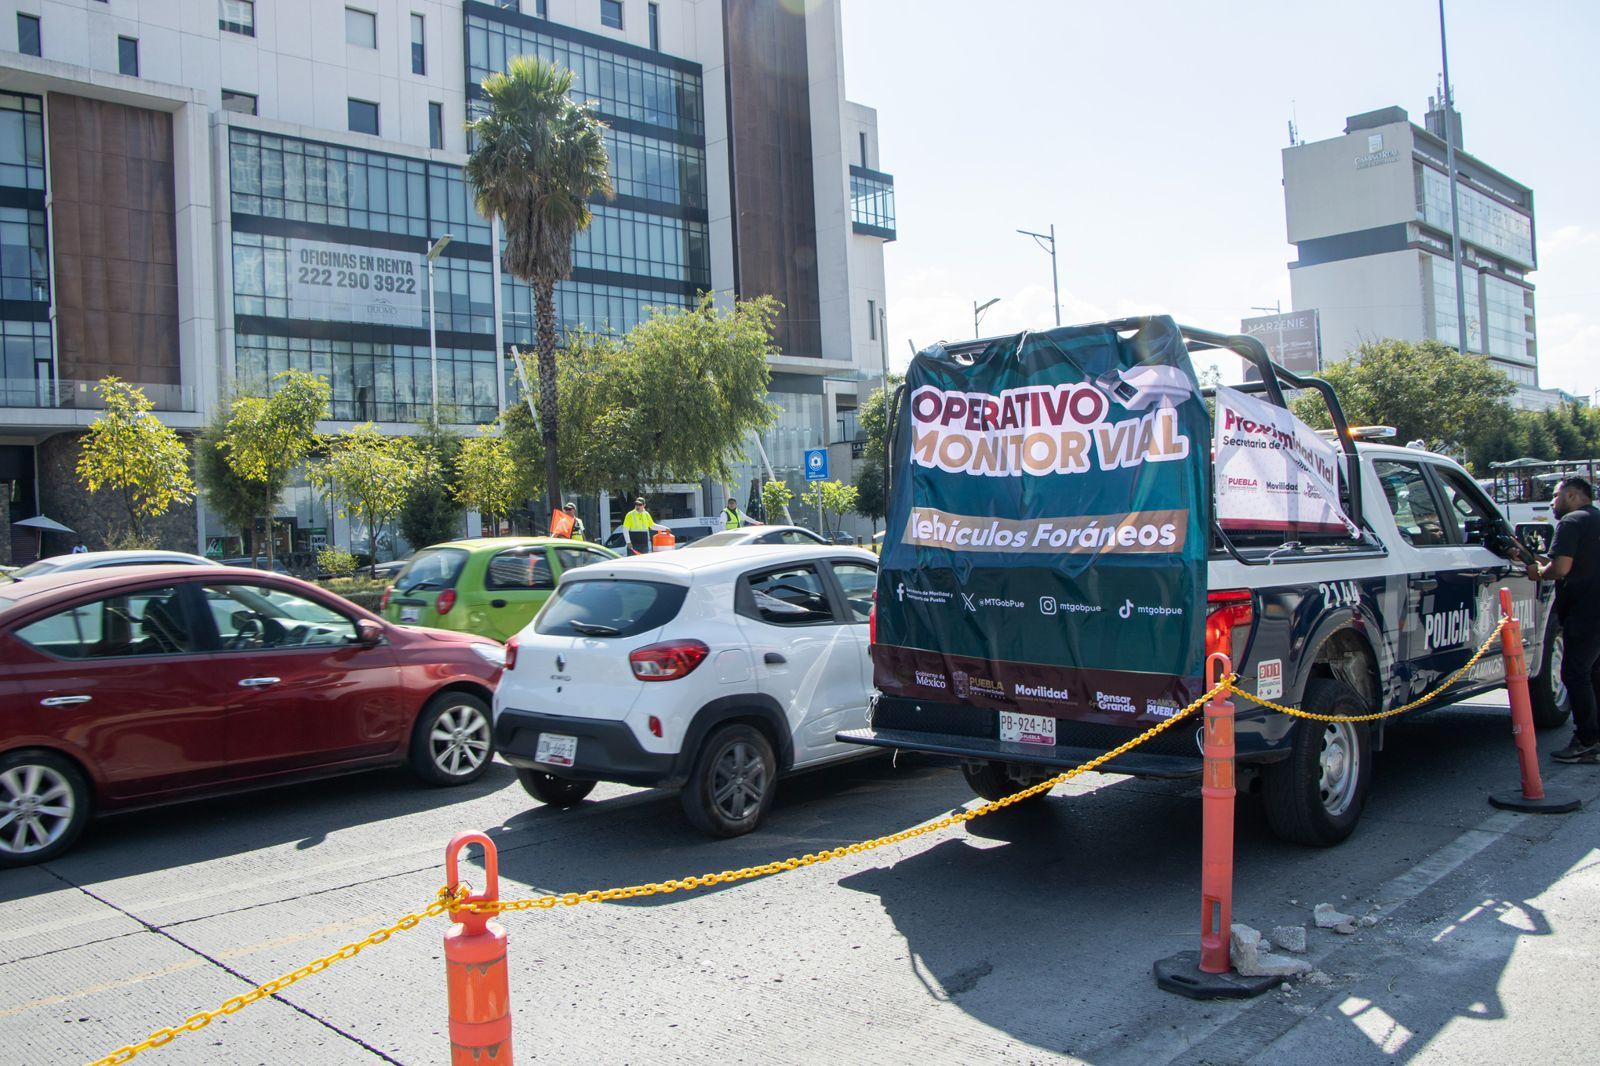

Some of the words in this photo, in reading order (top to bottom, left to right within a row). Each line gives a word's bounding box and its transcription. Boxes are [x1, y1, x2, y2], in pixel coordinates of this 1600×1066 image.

[300, 248, 357, 269] OFICINAS
[360, 254, 375, 272] EN
[377, 257, 414, 276] RENTA
[298, 267, 333, 287] 222
[337, 271, 370, 290] 290
[373, 274, 416, 295] 3922
[911, 388, 1103, 432] OPERATIVO
[911, 425, 1087, 472] MONITOR
[1099, 415, 1184, 465] VIAL
[1269, 439, 1281, 450] de
[1315, 453, 1334, 486] Vial
[1228, 478, 1258, 487] PUEBLA
[1031, 520, 1176, 549] Foráneos
[1059, 602, 1102, 613] mtgobpue
[1137, 605, 1183, 616] mtgobpue
[1424, 602, 1470, 651] POLICÍA
[1260, 663, 1280, 679] 911
[916, 676, 946, 688] México
[969, 677, 1004, 690] PUEBLA
[1015, 684, 1069, 700] Movilidad
[1096, 691, 1132, 704] Pensar
[1098, 700, 1137, 713] Grande
[1001, 715, 1053, 734] PB-924-A3
